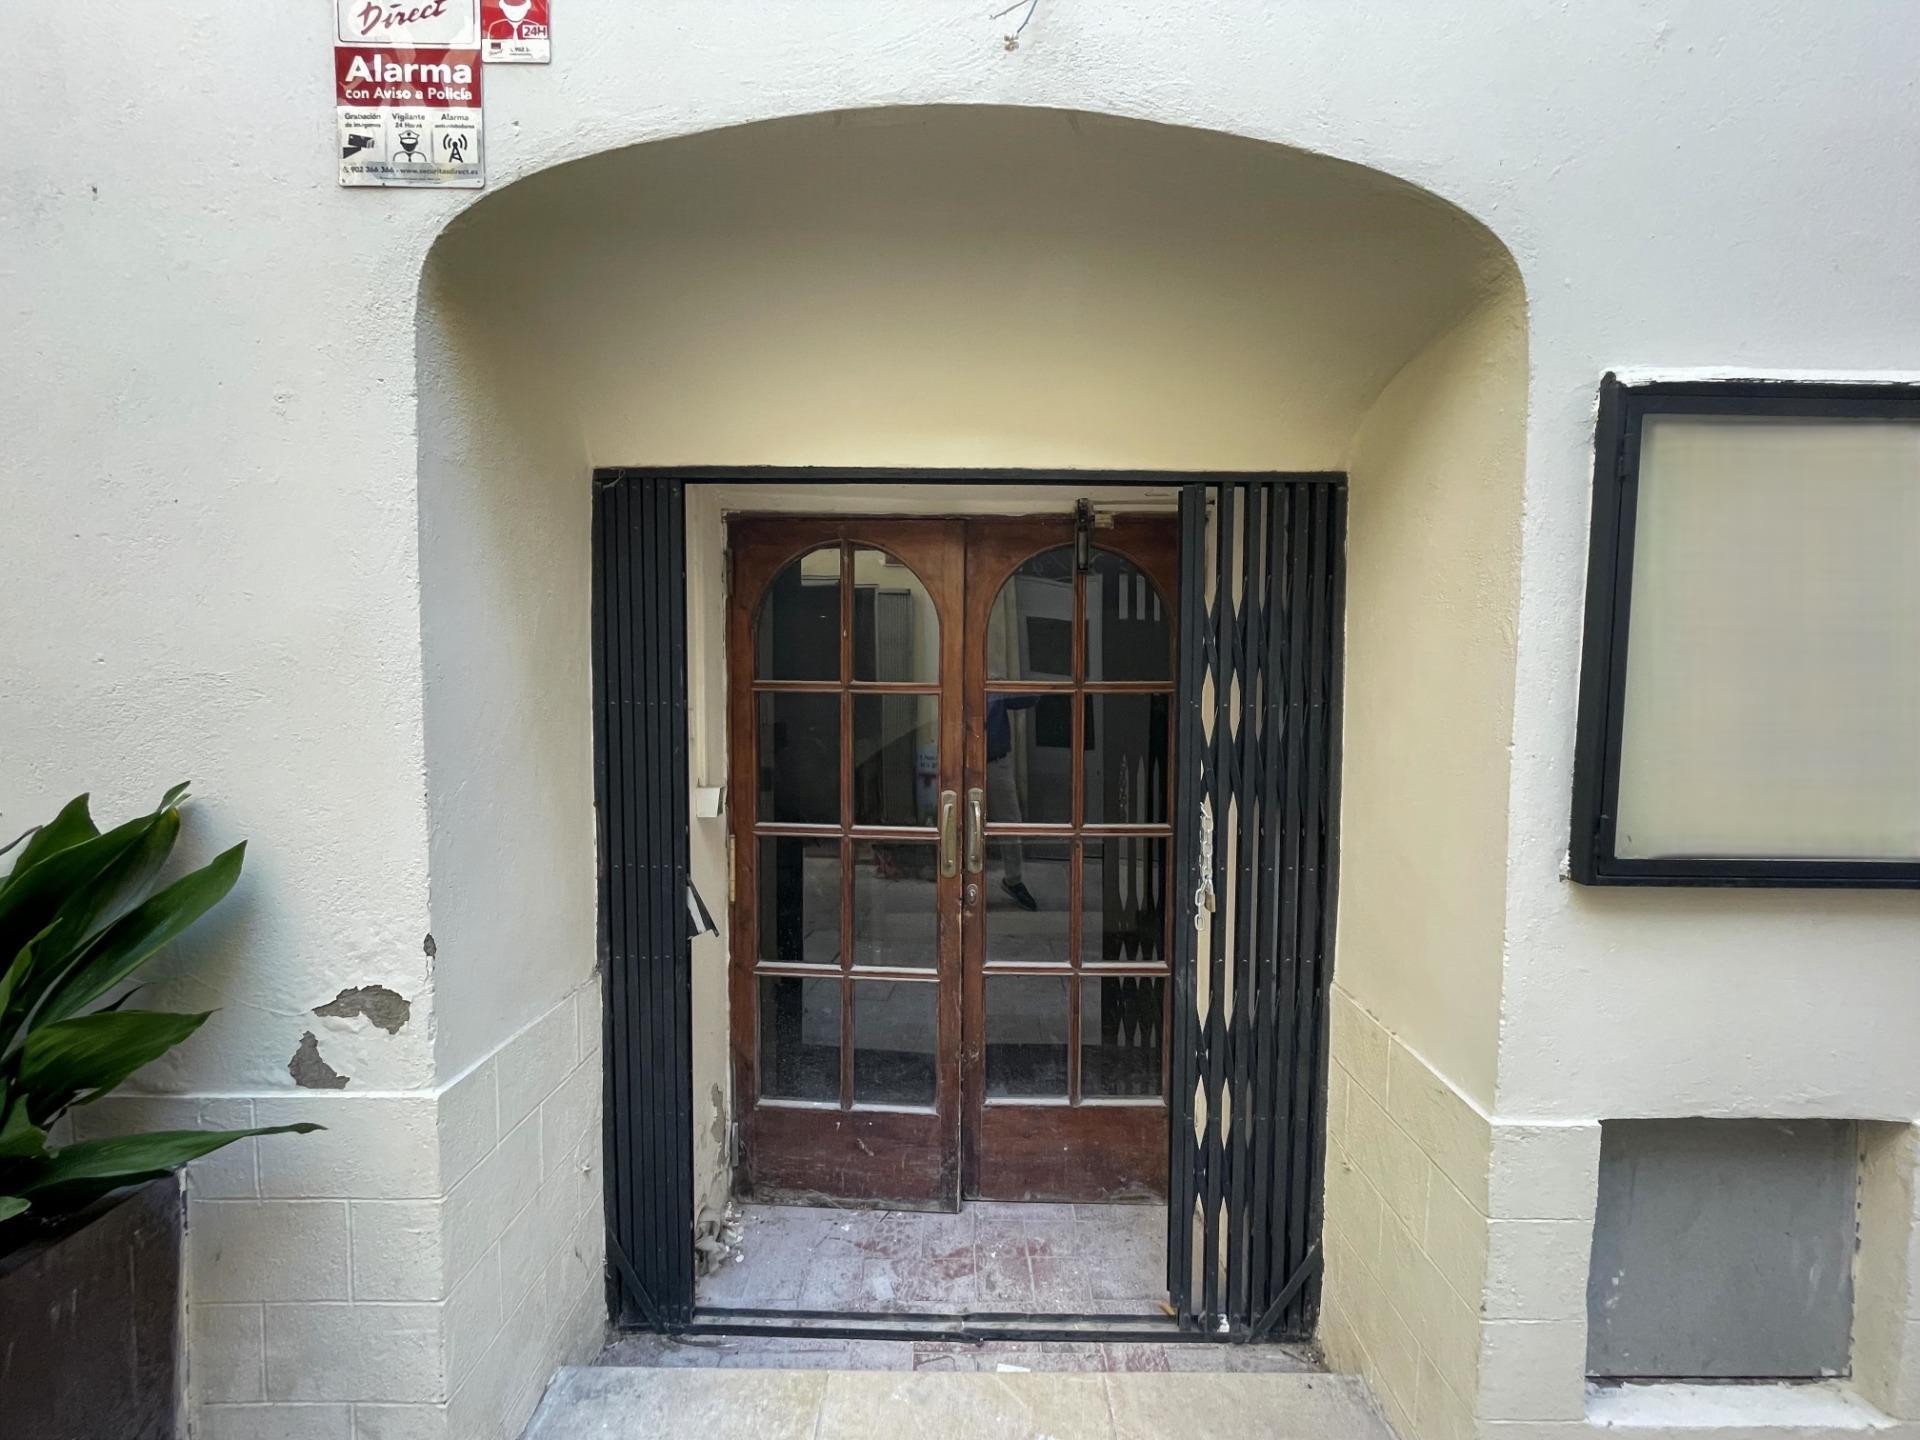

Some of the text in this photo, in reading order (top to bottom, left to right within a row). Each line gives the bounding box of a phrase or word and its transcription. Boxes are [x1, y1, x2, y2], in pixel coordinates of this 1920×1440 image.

[524, 26, 546, 36] 24H
[345, 54, 472, 83] Alarma
[345, 87, 472, 100] con Aviso a Policía
[392, 113, 425, 121] Vigilante
